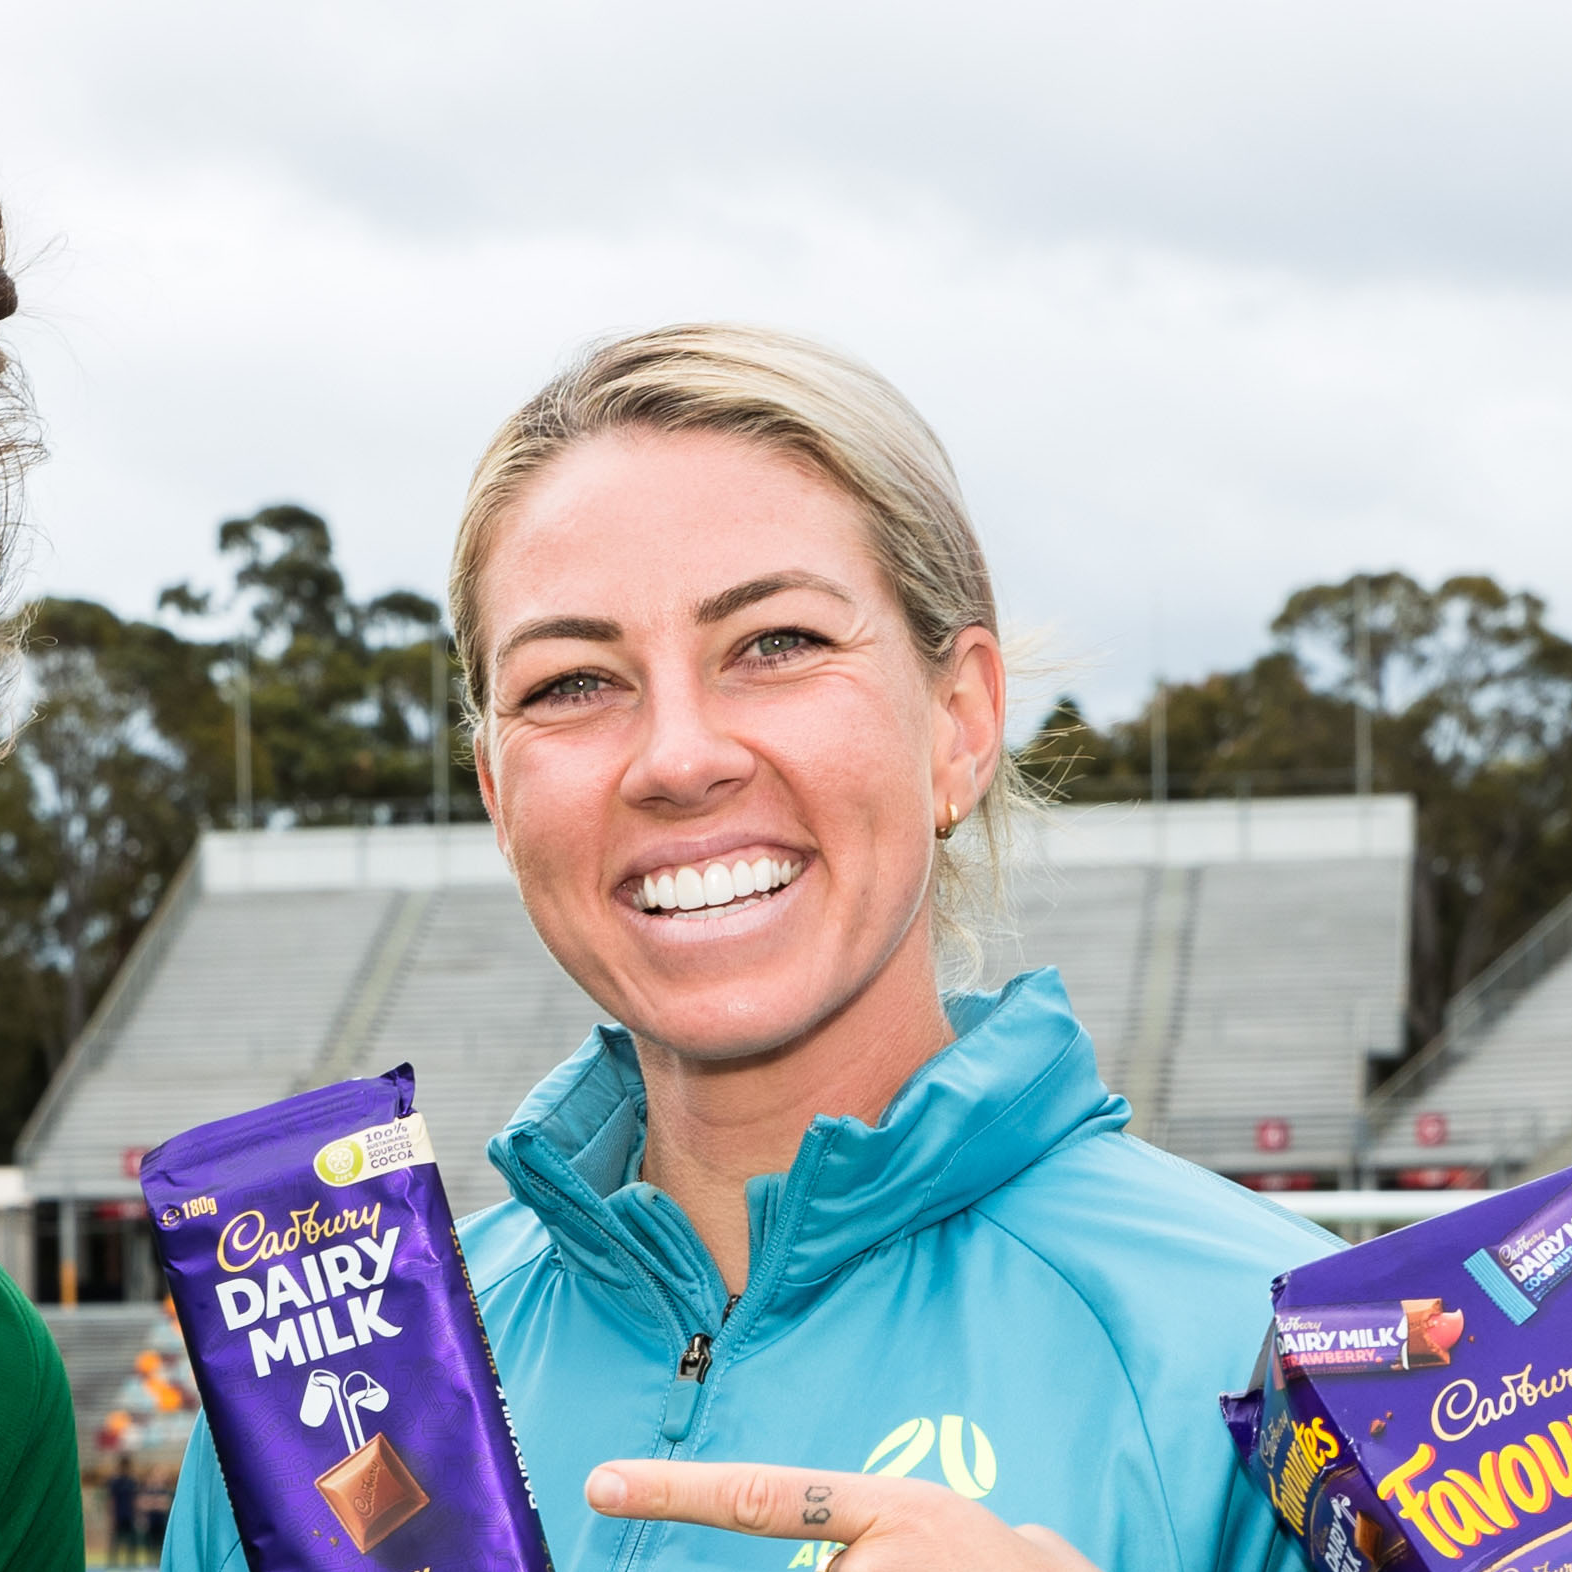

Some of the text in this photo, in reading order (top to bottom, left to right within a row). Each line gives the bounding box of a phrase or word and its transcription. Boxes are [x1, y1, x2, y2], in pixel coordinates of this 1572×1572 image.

[368, 1140, 412, 1159] SOURCED
[370, 1150, 415, 1170] COCOA
[181, 1195, 218, 1219] 180g
[216, 1200, 382, 1273] Cadbury
[1498, 1229, 1547, 1267] Cadbury
[1508, 1227, 1566, 1283] DAIRY
[215, 1226, 400, 1331] DAIRY
[248, 1288, 403, 1378] MILK
[1277, 1327, 1400, 1356] DAIRY MILK
[1267, 1416, 1341, 1537] Favourites
